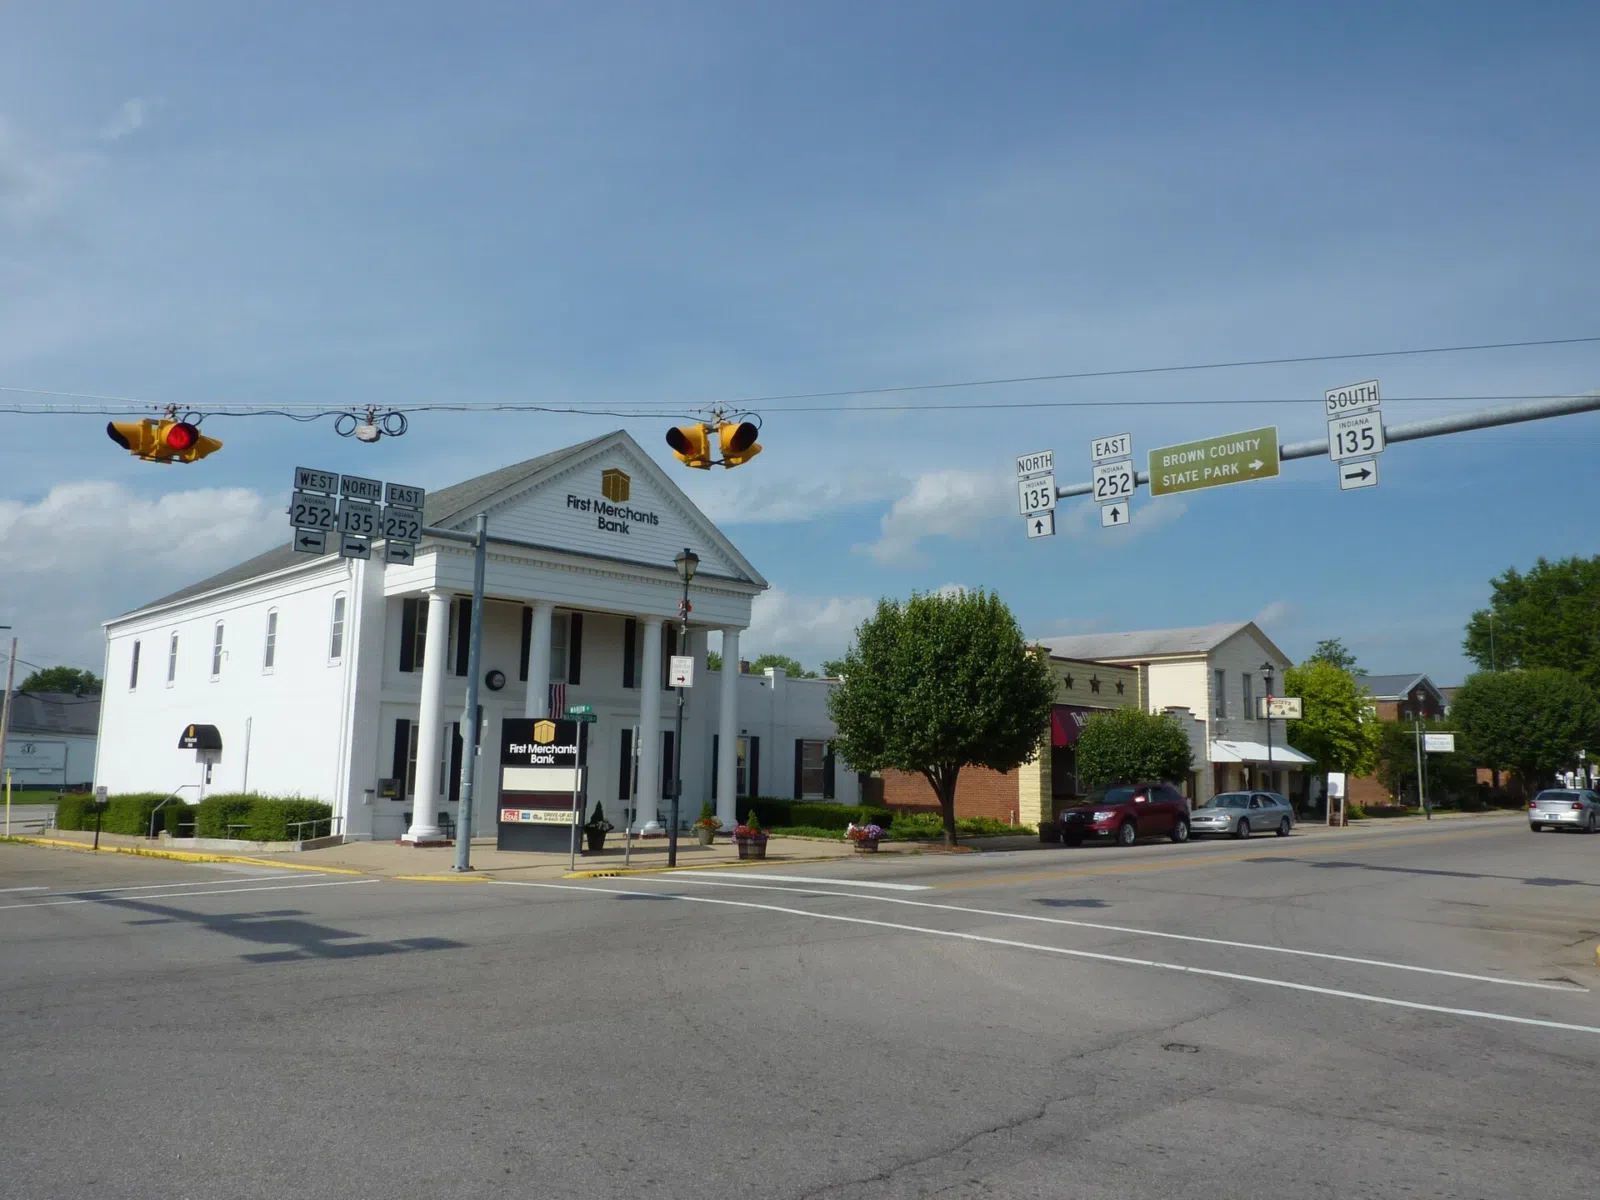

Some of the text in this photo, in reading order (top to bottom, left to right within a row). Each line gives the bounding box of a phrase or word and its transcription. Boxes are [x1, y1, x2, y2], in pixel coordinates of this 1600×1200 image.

[1328, 385, 1377, 410] SOUTH
[1339, 418, 1369, 430] INDIANA
[1096, 438, 1126, 457] EAST
[1337, 427, 1374, 455] 135
[1163, 438, 1261, 467] BROWN COUNTY
[1018, 454, 1052, 473] NORTH
[1101, 465, 1124, 474] INDIANA
[300, 472, 334, 490] WEST
[1163, 462, 1239, 487] STATE PARK
[343, 479, 380, 498] NORTH
[1026, 480, 1046, 489] INDIANA
[1097, 473, 1130, 497] 252
[302, 497, 326, 506] INDIANA
[391, 488, 420, 504] EAST
[1024, 487, 1050, 510] 135
[295, 504, 331, 527] 252
[348, 504, 372, 513] INDIANA
[392, 511, 415, 520] INDIANA
[567, 494, 659, 525] First Merchants
[344, 512, 373, 533] 135
[386, 518, 419, 540] 252
[598, 516, 630, 535] Bank
[510, 744, 577, 754] First Merchants
[530, 754, 554, 764] Bank
